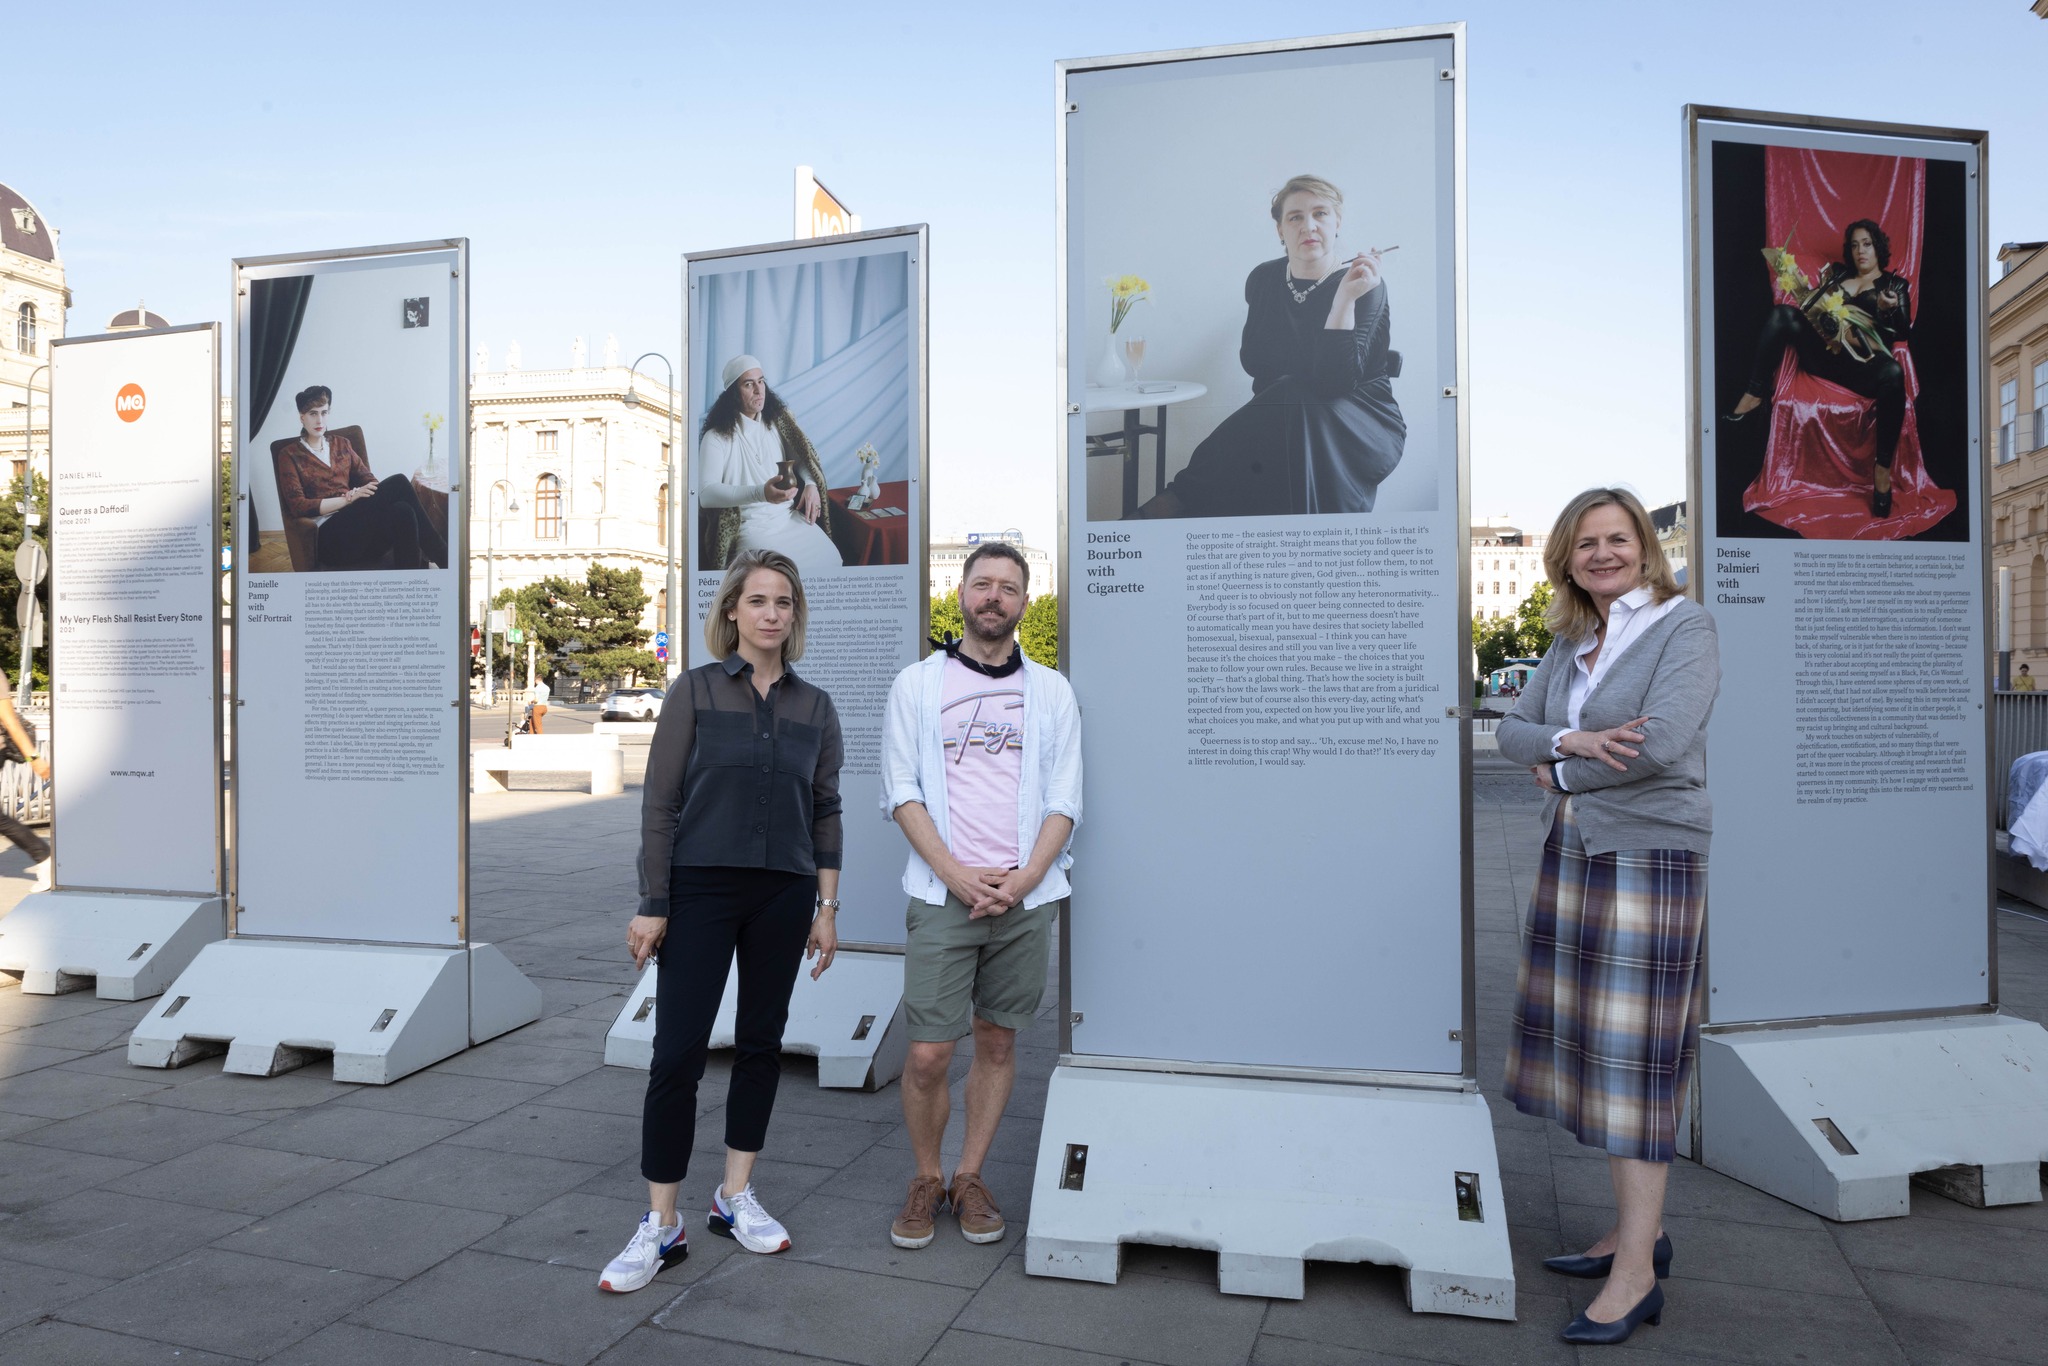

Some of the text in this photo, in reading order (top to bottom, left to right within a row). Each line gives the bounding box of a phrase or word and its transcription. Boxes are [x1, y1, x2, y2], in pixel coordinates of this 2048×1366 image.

[118, 394, 144, 411] MQ
[60, 507, 82, 516] Queer
[100, 505, 129, 514] Daffodil
[1087, 532, 1130, 543] Denice
[1186, 542, 1199, 550] the
[1200, 541, 1234, 552] opposite
[1236, 540, 1244, 549] of
[1246, 540, 1278, 551] straight.
[1280, 539, 1311, 550] Straight
[1341, 538, 1358, 546] that
[1359, 540, 1374, 548] you
[1376, 537, 1402, 546] follow
[1403, 536, 1417, 545] the
[1087, 549, 1142, 560] Bourbon
[1186, 552, 1206, 560] rules
[1208, 551, 1223, 560] that
[1239, 551, 1260, 561] given
[1262, 551, 1271, 559] to
[1272, 552, 1287, 561] you
[1288, 550, 1299, 560] by
[1300, 549, 1342, 558] normative
[1343, 548, 1372, 559] society
[1373, 548, 1389, 556] and
[1390, 549, 1414, 558] queer
[1416, 547, 1423, 555] is
[1425, 547, 1434, 555] to
[1717, 548, 1751, 558] Denise
[1872, 552, 1902, 562] embracing
[1915, 554, 1947, 562] acceptance.
[1087, 565, 1115, 577] with
[1717, 563, 1760, 573] Palmieri
[1186, 572, 1198, 581] act
[1210, 572, 1217, 580] if
[1218, 571, 1253, 582] anything
[1262, 571, 1289, 579] nature
[1290, 570, 1315, 581] given,
[1316, 569, 1334, 578] God
[1367, 568, 1399, 579] nothing
[1409, 568, 1440, 576] written
[1836, 571, 1867, 580] embracing
[1868, 571, 1888, 580] myself,
[1914, 572, 1937, 581] noticing
[1938, 572, 1956, 581] people
[248, 580, 278, 588] Danielle
[698, 577, 720, 586] Pêdra
[1196, 582, 1220, 591] stone!
[1222, 581, 1264, 592] Queerness
[1273, 582, 1282, 590] to
[1283, 580, 1325, 592] constantly
[1326, 580, 1362, 591] question
[1363, 579, 1381, 588] this.
[1717, 579, 1739, 589] with
[1087, 582, 1144, 597] Cigarette
[248, 592, 269, 601] Pamp
[1717, 594, 1766, 604] Chainsaw
[248, 603, 264, 611] with
[60, 613, 203, 625] My Very Flesh Shall Resist Every Stone
[248, 614, 292, 622] Self Portrait
[1229, 747, 1252, 758] doing
[1254, 747, 1269, 755] this
[1270, 747, 1290, 758] crap!
[1292, 747, 1311, 758] Why
[1312, 747, 1338, 756] would
[1339, 747, 1343, 756] I
[1344, 747, 1355, 756] do
[1396, 749, 1420, 758] every
[1421, 747, 1436, 758] day
[1194, 757, 1213, 766] little
[1214, 757, 1258, 768] revolution,
[1259, 757, 1262, 766] I
[1264, 757, 1289, 766] would
[1290, 760, 1306, 768] say.
[110, 769, 155, 778] www.mqw.at
